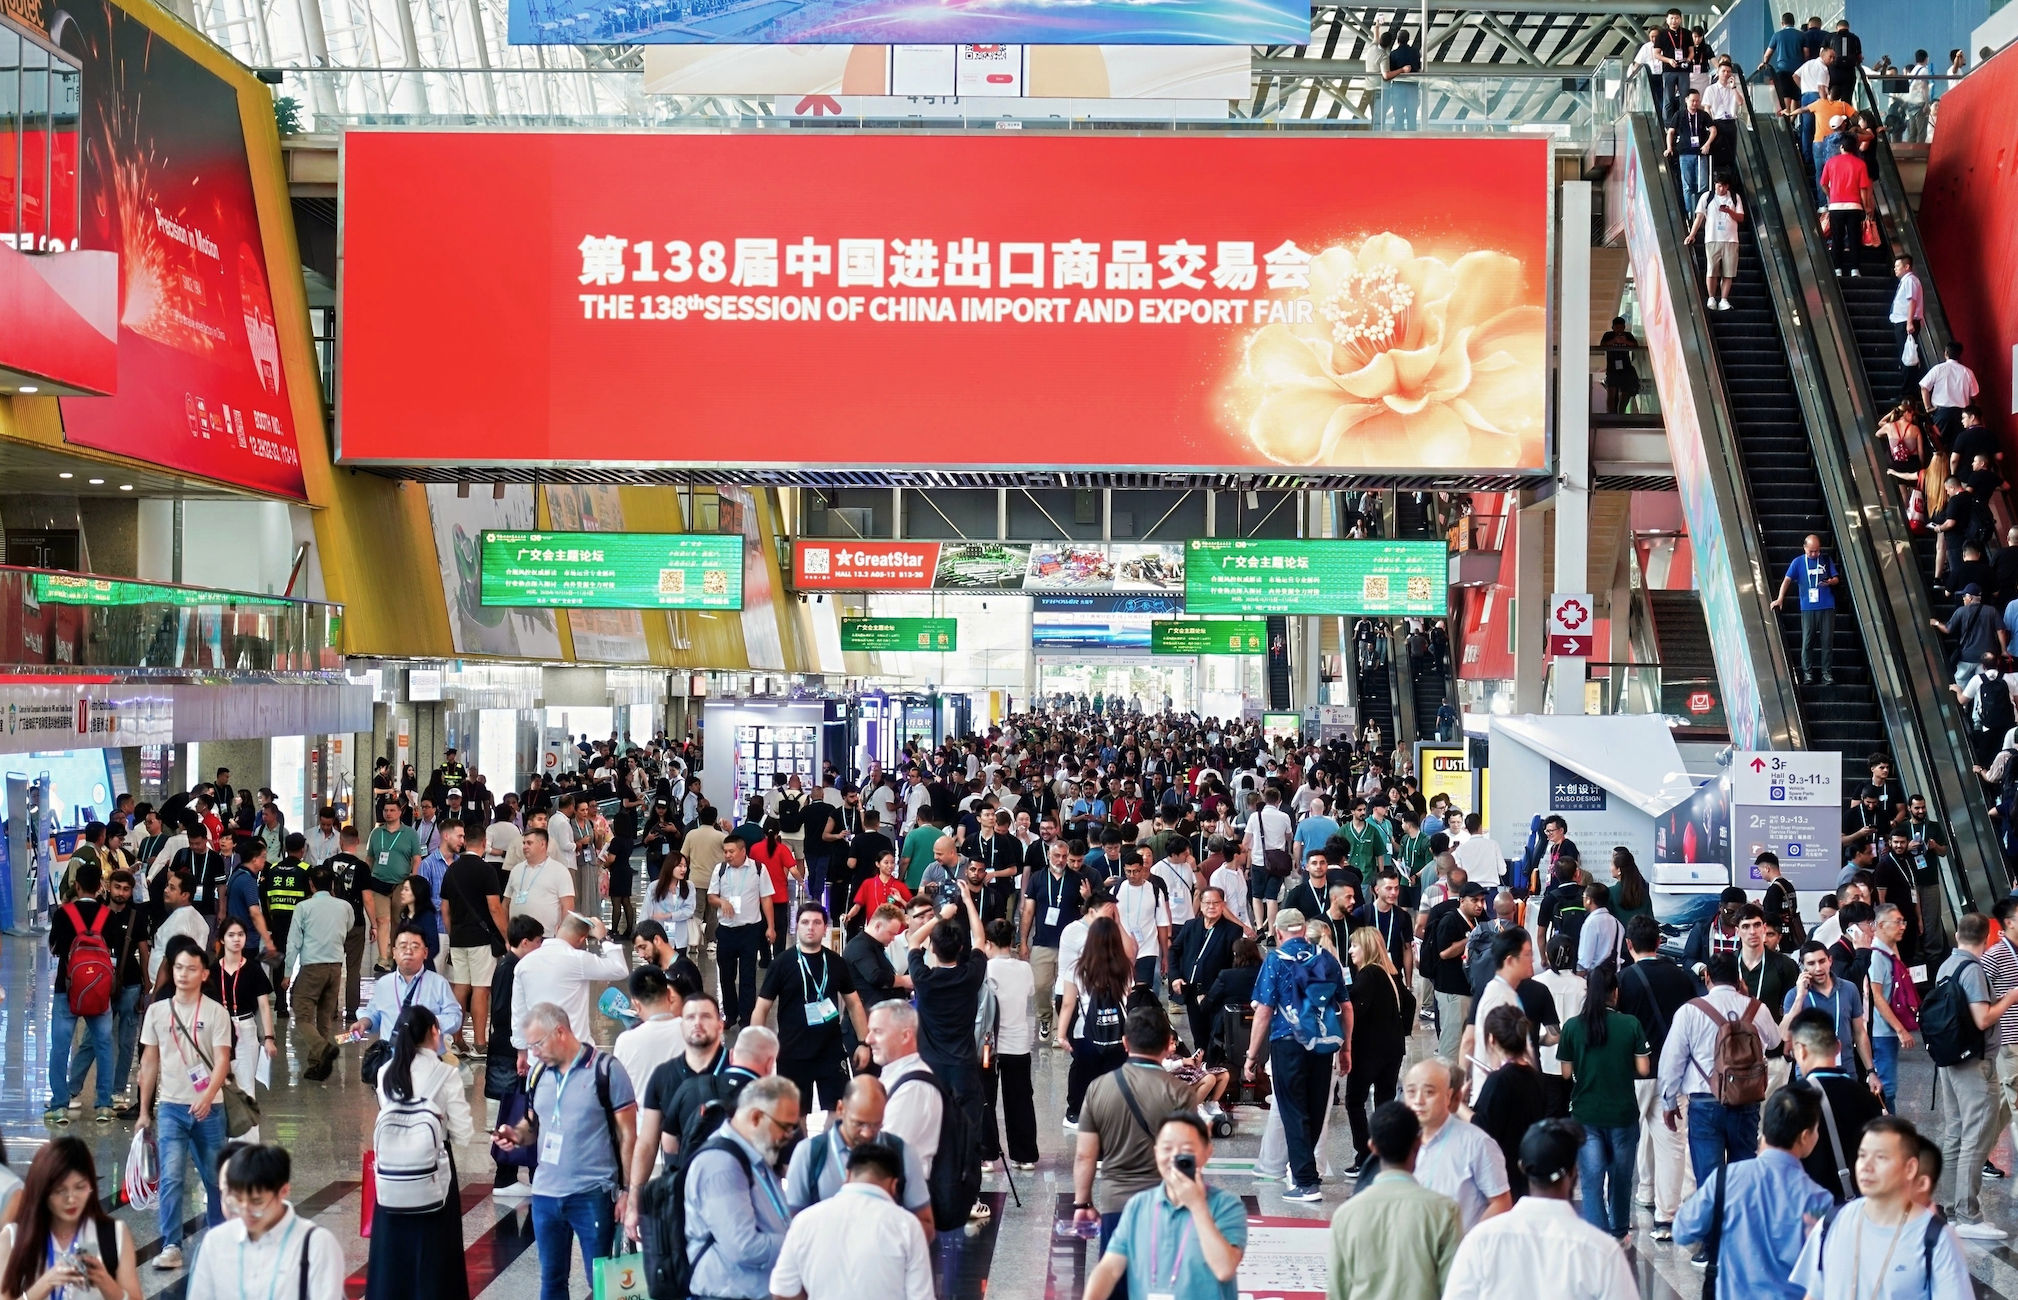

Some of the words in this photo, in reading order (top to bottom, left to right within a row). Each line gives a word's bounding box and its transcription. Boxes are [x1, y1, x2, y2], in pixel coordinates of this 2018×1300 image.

[155, 207, 189, 246] Precision
[187, 224, 196, 249] in
[195, 228, 220, 261] Motion
[578, 234, 1314, 290] 第138届中国进出口商品交易会
[579, 294, 634, 320] THE
[826, 296, 866, 322] OF
[869, 296, 957, 322] CHINA
[961, 297, 1071, 322] IMPORT
[1073, 298, 1134, 323] AND
[1139, 299, 1249, 324] EXPORT
[1253, 299, 1314, 324] FAIR
[253, 410, 272, 433] BOOTH
[517, 548, 604, 562] 广交会主题论坛
[854, 551, 924, 567] GreatStar
[1222, 555, 1309, 569] 广交会主题论坛
[835, 570, 852, 578] HALL
[1771, 757, 1787, 770] 3F
[1788, 773, 1830, 785] 9.3-11.3
[1555, 784, 1601, 795] 大创设计
[1750, 814, 1766, 828] 2F
[1780, 815, 1808, 824] 9.2-13.2
[273, 876, 295, 888] 安保
[271, 896, 297, 904] Security
